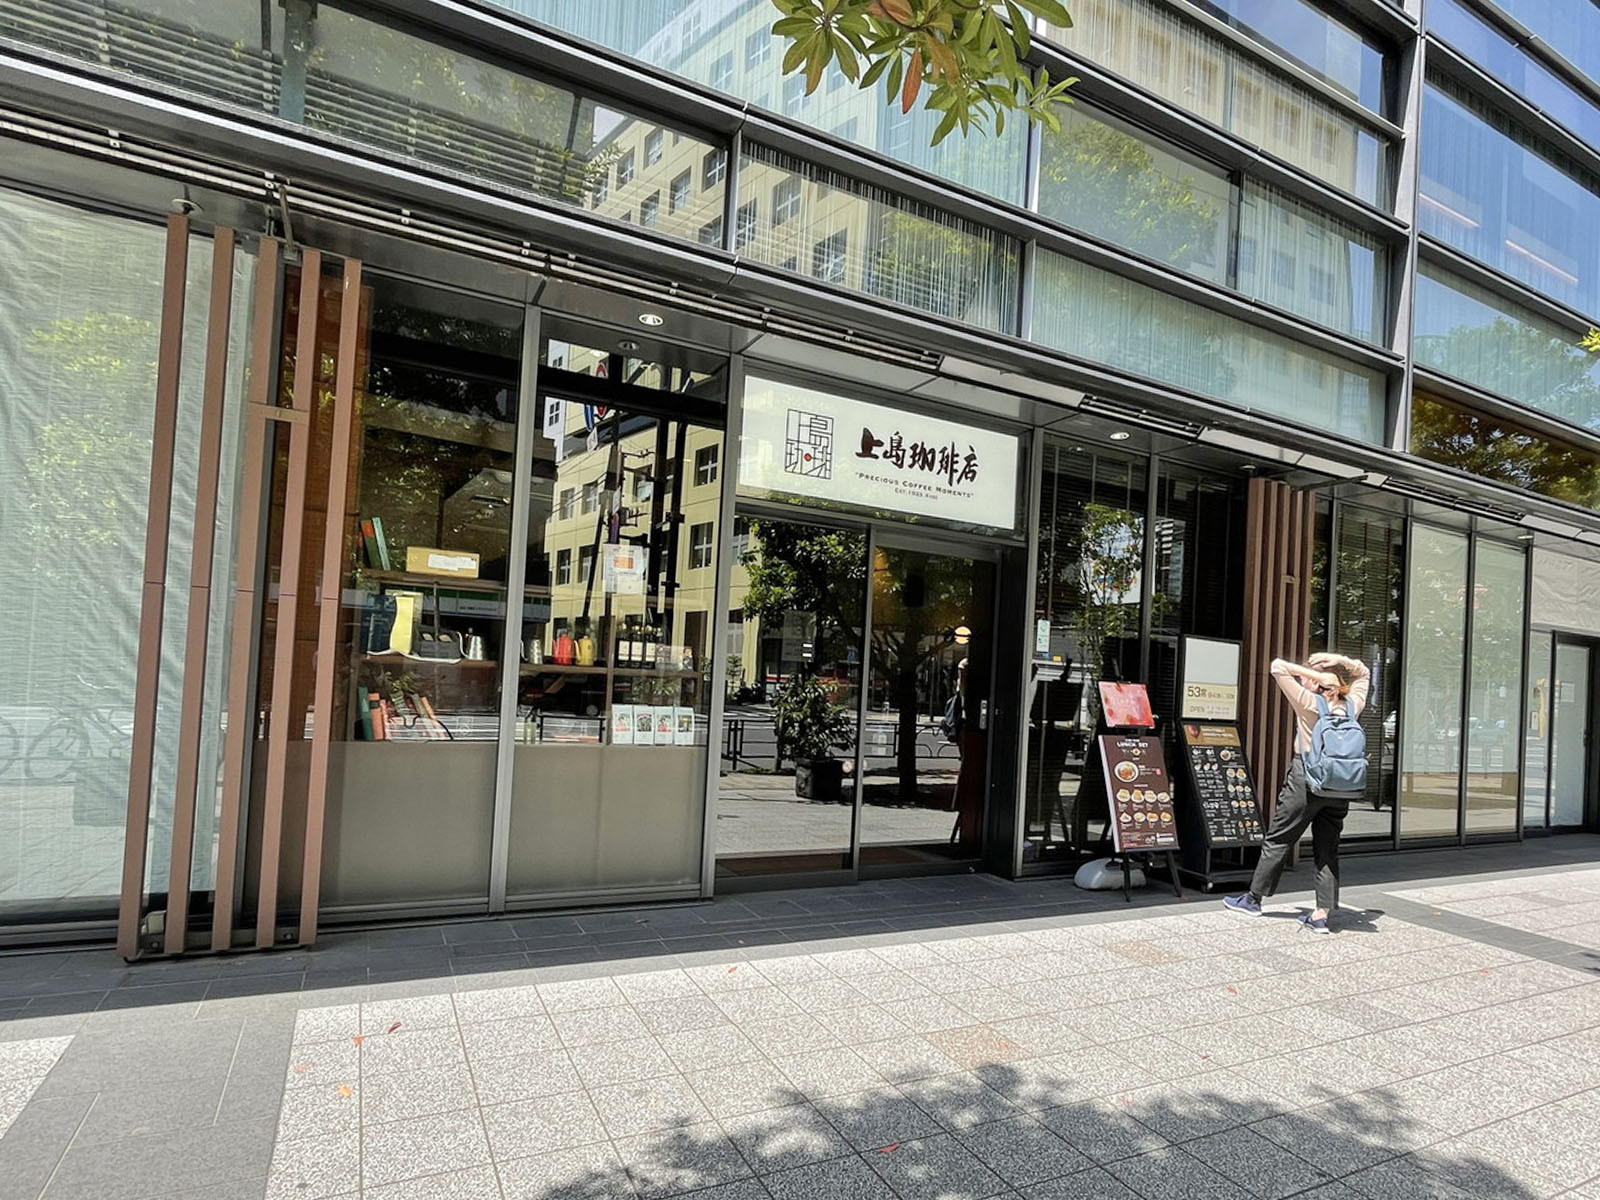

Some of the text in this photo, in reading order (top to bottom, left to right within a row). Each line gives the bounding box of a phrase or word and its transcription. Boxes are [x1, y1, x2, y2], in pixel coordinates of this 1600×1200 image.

[855, 427, 979, 487] 上島珈琲店
